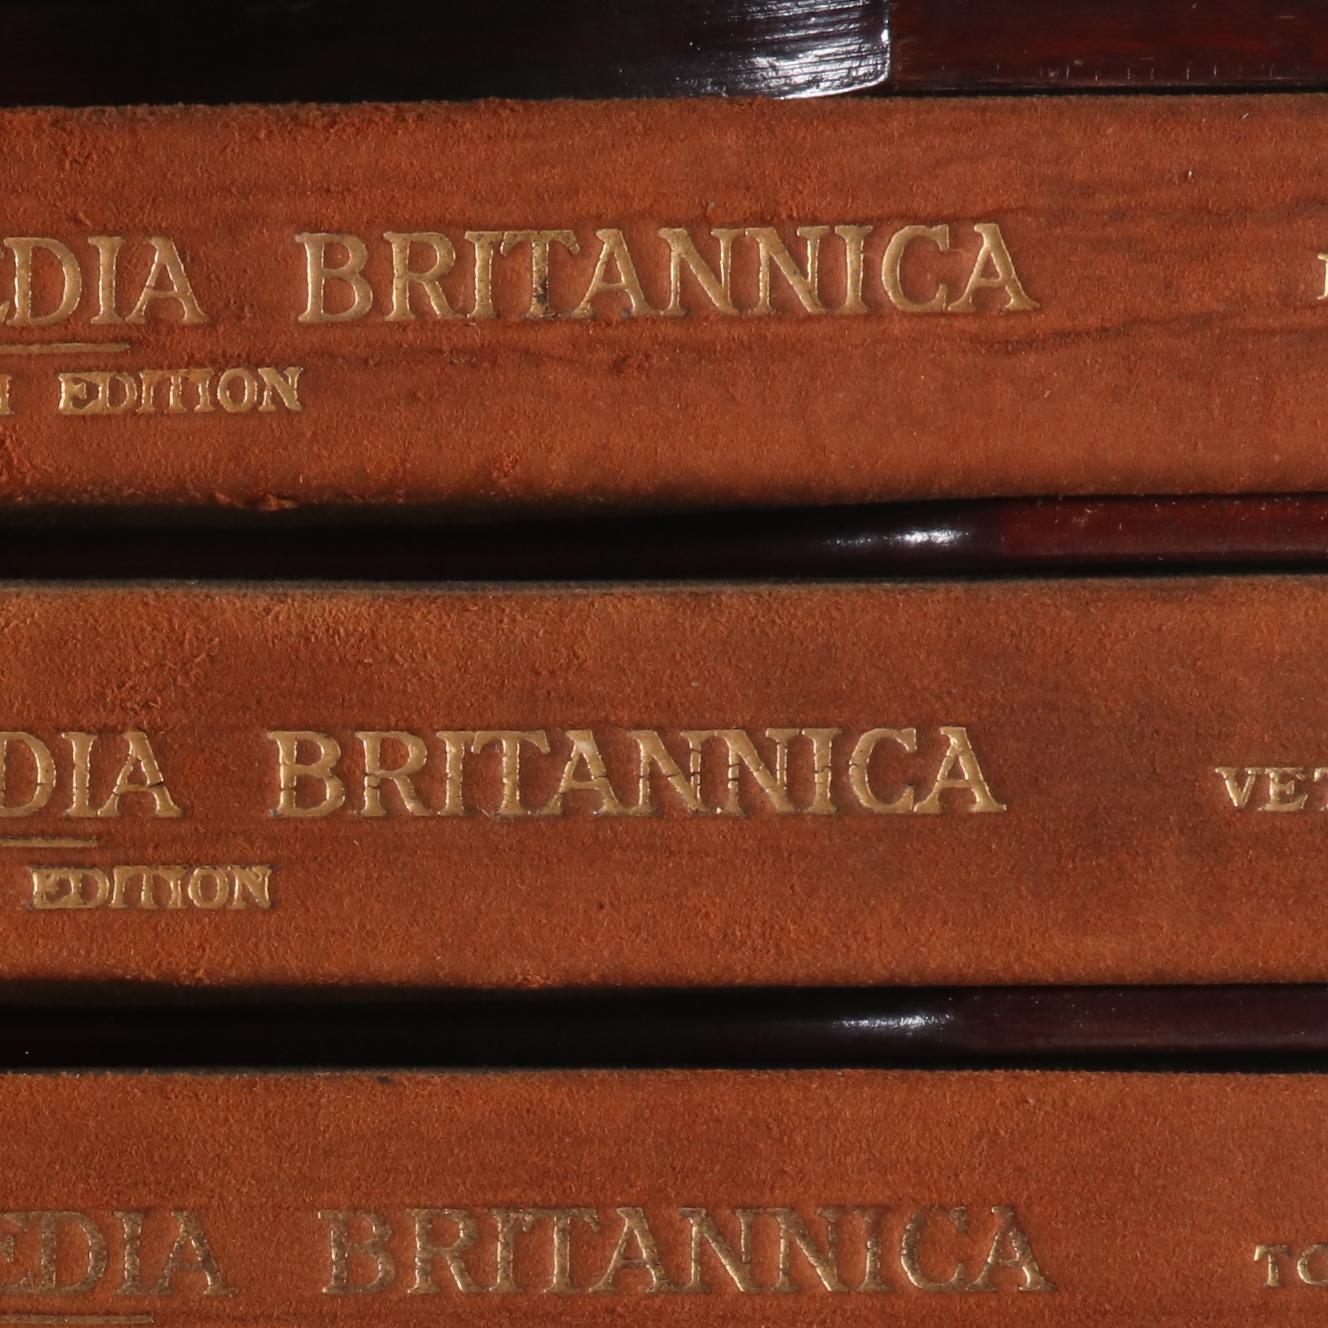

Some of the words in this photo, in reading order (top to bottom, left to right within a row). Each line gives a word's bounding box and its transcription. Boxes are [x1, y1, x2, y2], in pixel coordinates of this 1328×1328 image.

[293, 221, 1039, 320] BRITANNICA
[56, 367, 303, 415] EDITION
[266, 726, 1007, 817] BRITANNICA
[27, 865, 272, 910] EDITION
[316, 1206, 1056, 1294] BRITANNICA
